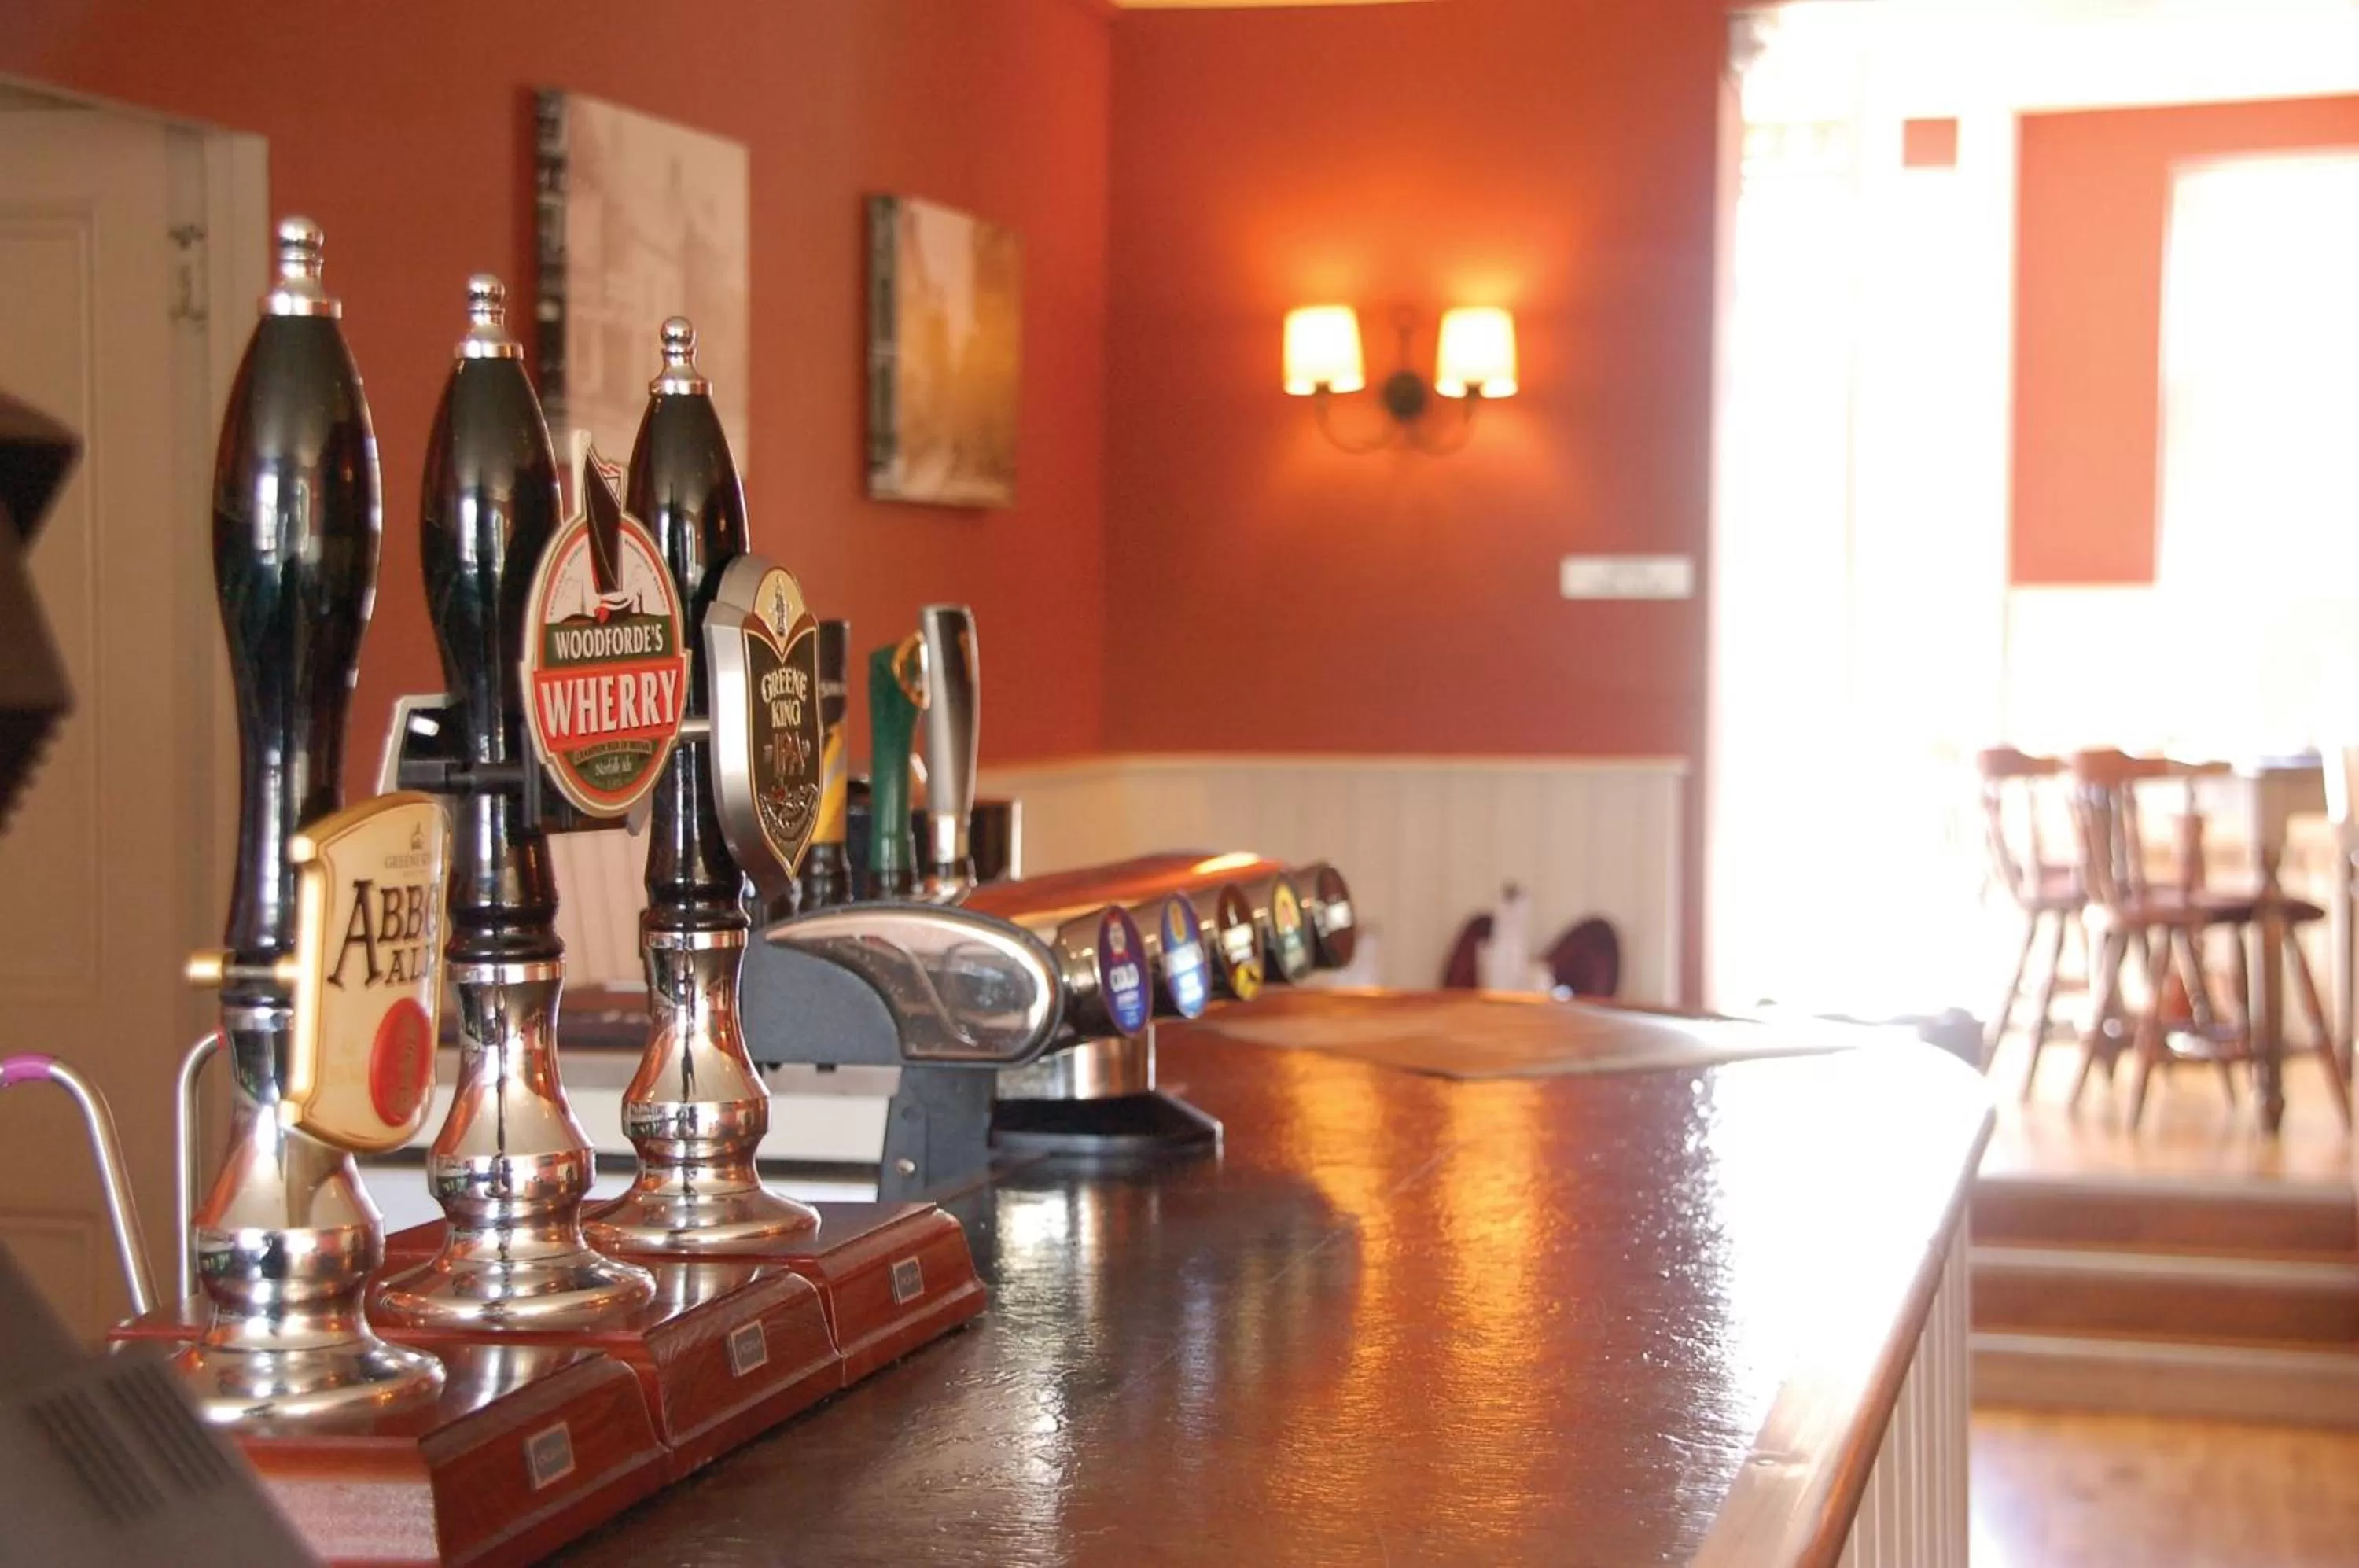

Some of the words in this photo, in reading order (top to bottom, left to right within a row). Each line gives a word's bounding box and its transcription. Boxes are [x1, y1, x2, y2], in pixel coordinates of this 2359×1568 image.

[554, 624, 664, 661] WOODFORDE'S
[540, 669, 677, 738] WHERRY
[761, 666, 808, 704] GREENE
[771, 698, 801, 728] KING
[326, 878, 440, 989] ABBO
